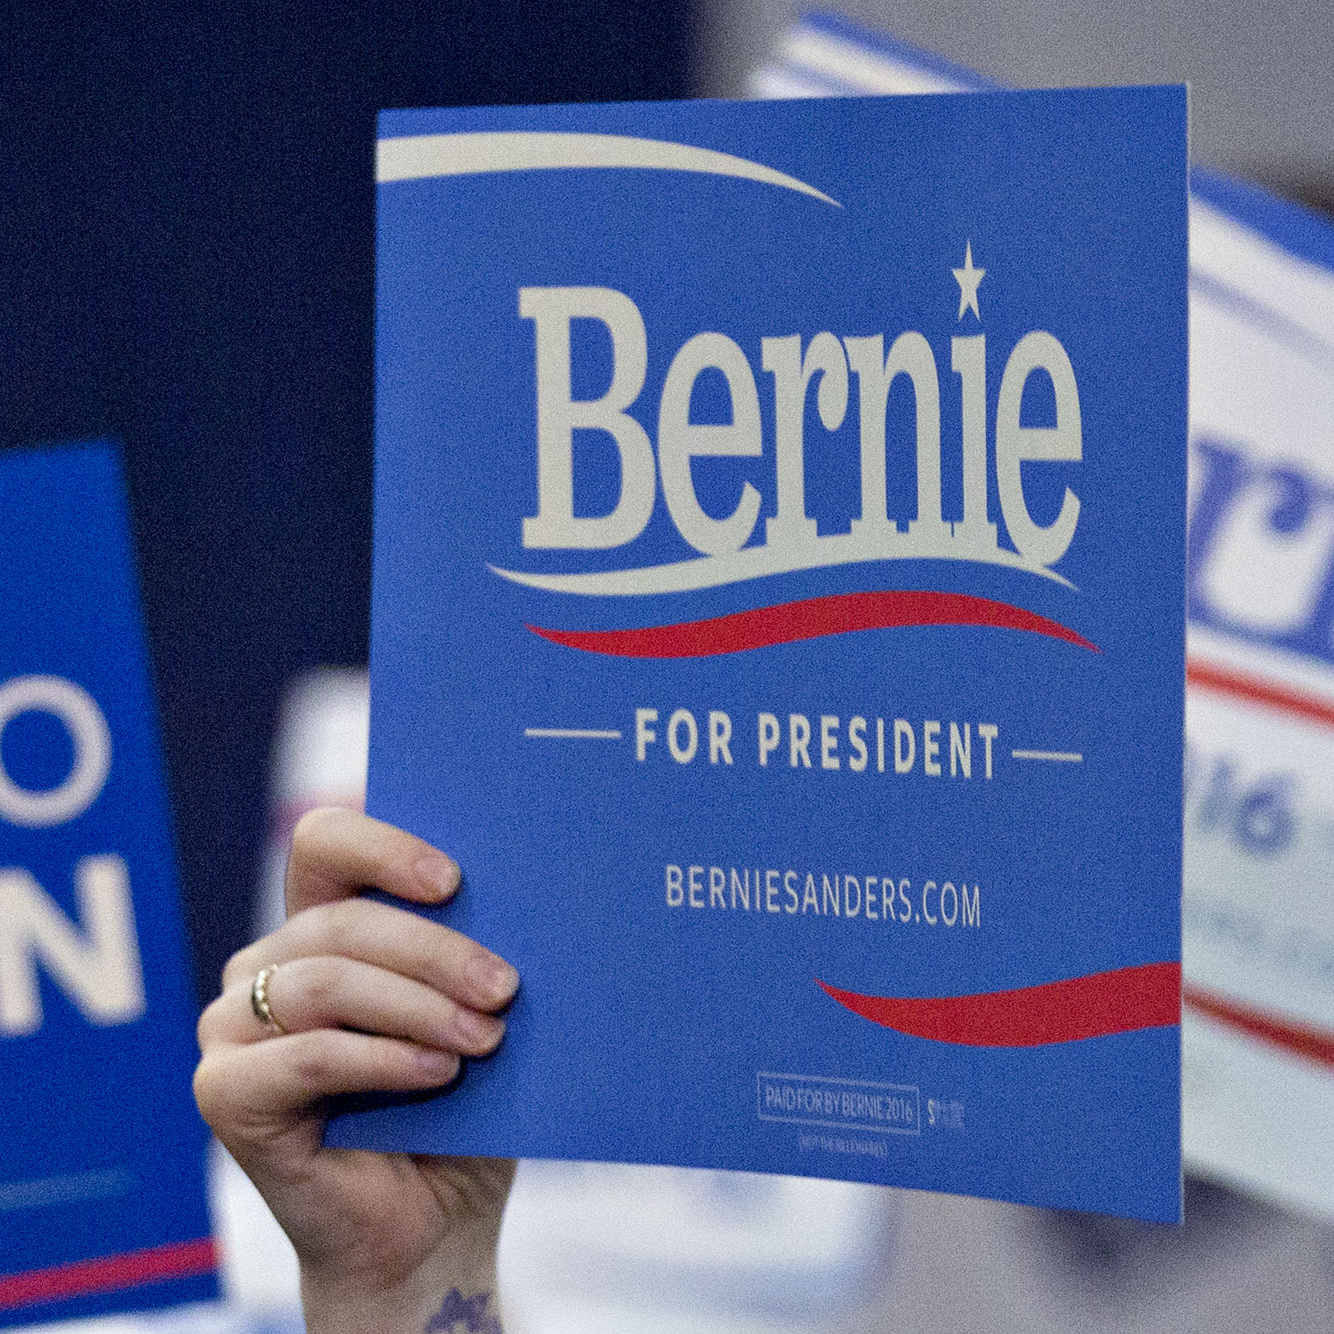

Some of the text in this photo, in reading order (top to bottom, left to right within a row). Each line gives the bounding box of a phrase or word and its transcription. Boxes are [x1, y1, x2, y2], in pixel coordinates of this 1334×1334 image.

[516, 240, 1083, 568] Bernie
[635, 707, 1000, 781] FOR PRESIDENT
[665, 863, 981, 928] BERNIESANDERS.COM
[765, 1085, 796, 1111] PAID
[796, 1088, 823, 1115] FOR
[824, 1090, 842, 1115] BY
[842, 1091, 884, 1120] BERNIE
[884, 1096, 914, 1124] 2016
